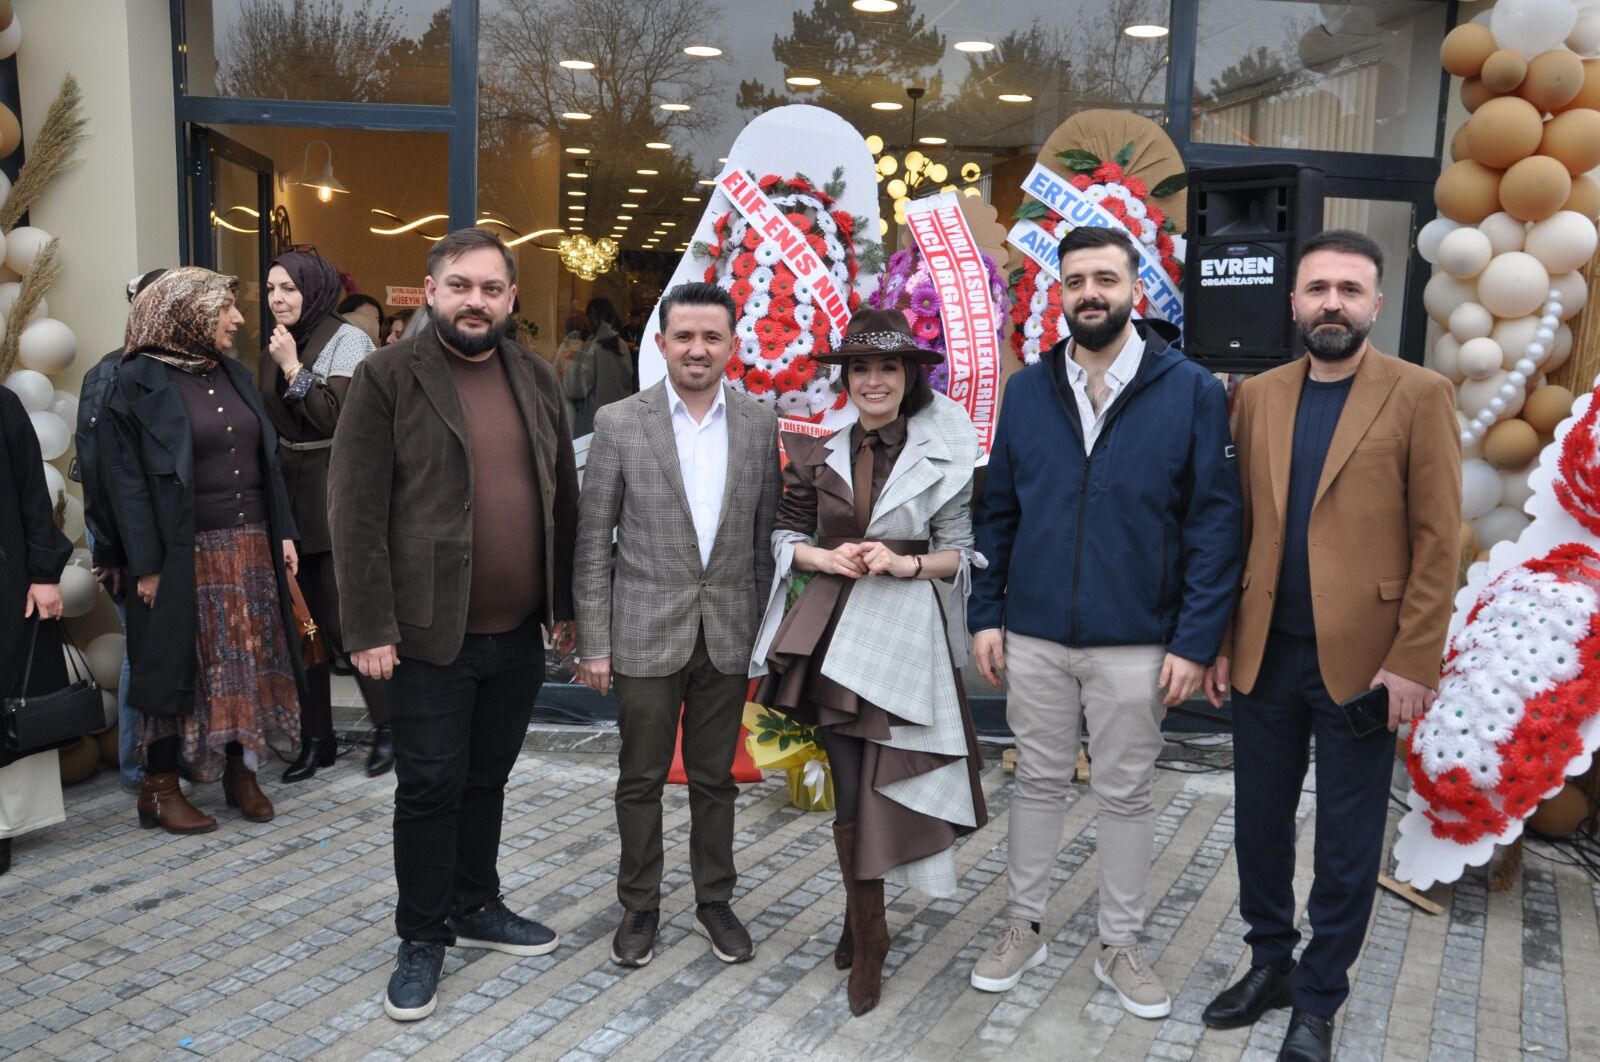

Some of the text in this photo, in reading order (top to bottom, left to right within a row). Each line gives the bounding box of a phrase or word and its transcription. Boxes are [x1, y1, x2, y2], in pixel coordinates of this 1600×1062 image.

[722, 169, 818, 277] ELİF-ENİS
[911, 212, 946, 253] İNCİ
[941, 206, 974, 258] HAYIRLI
[960, 260, 988, 315] OLSUN
[1201, 257, 1274, 276] EVREN
[1201, 276, 1274, 286] ORGANİZASYON
[392, 295, 420, 304] HÜSEYİN
[784, 421, 833, 437] DİLEKLERİMİ
